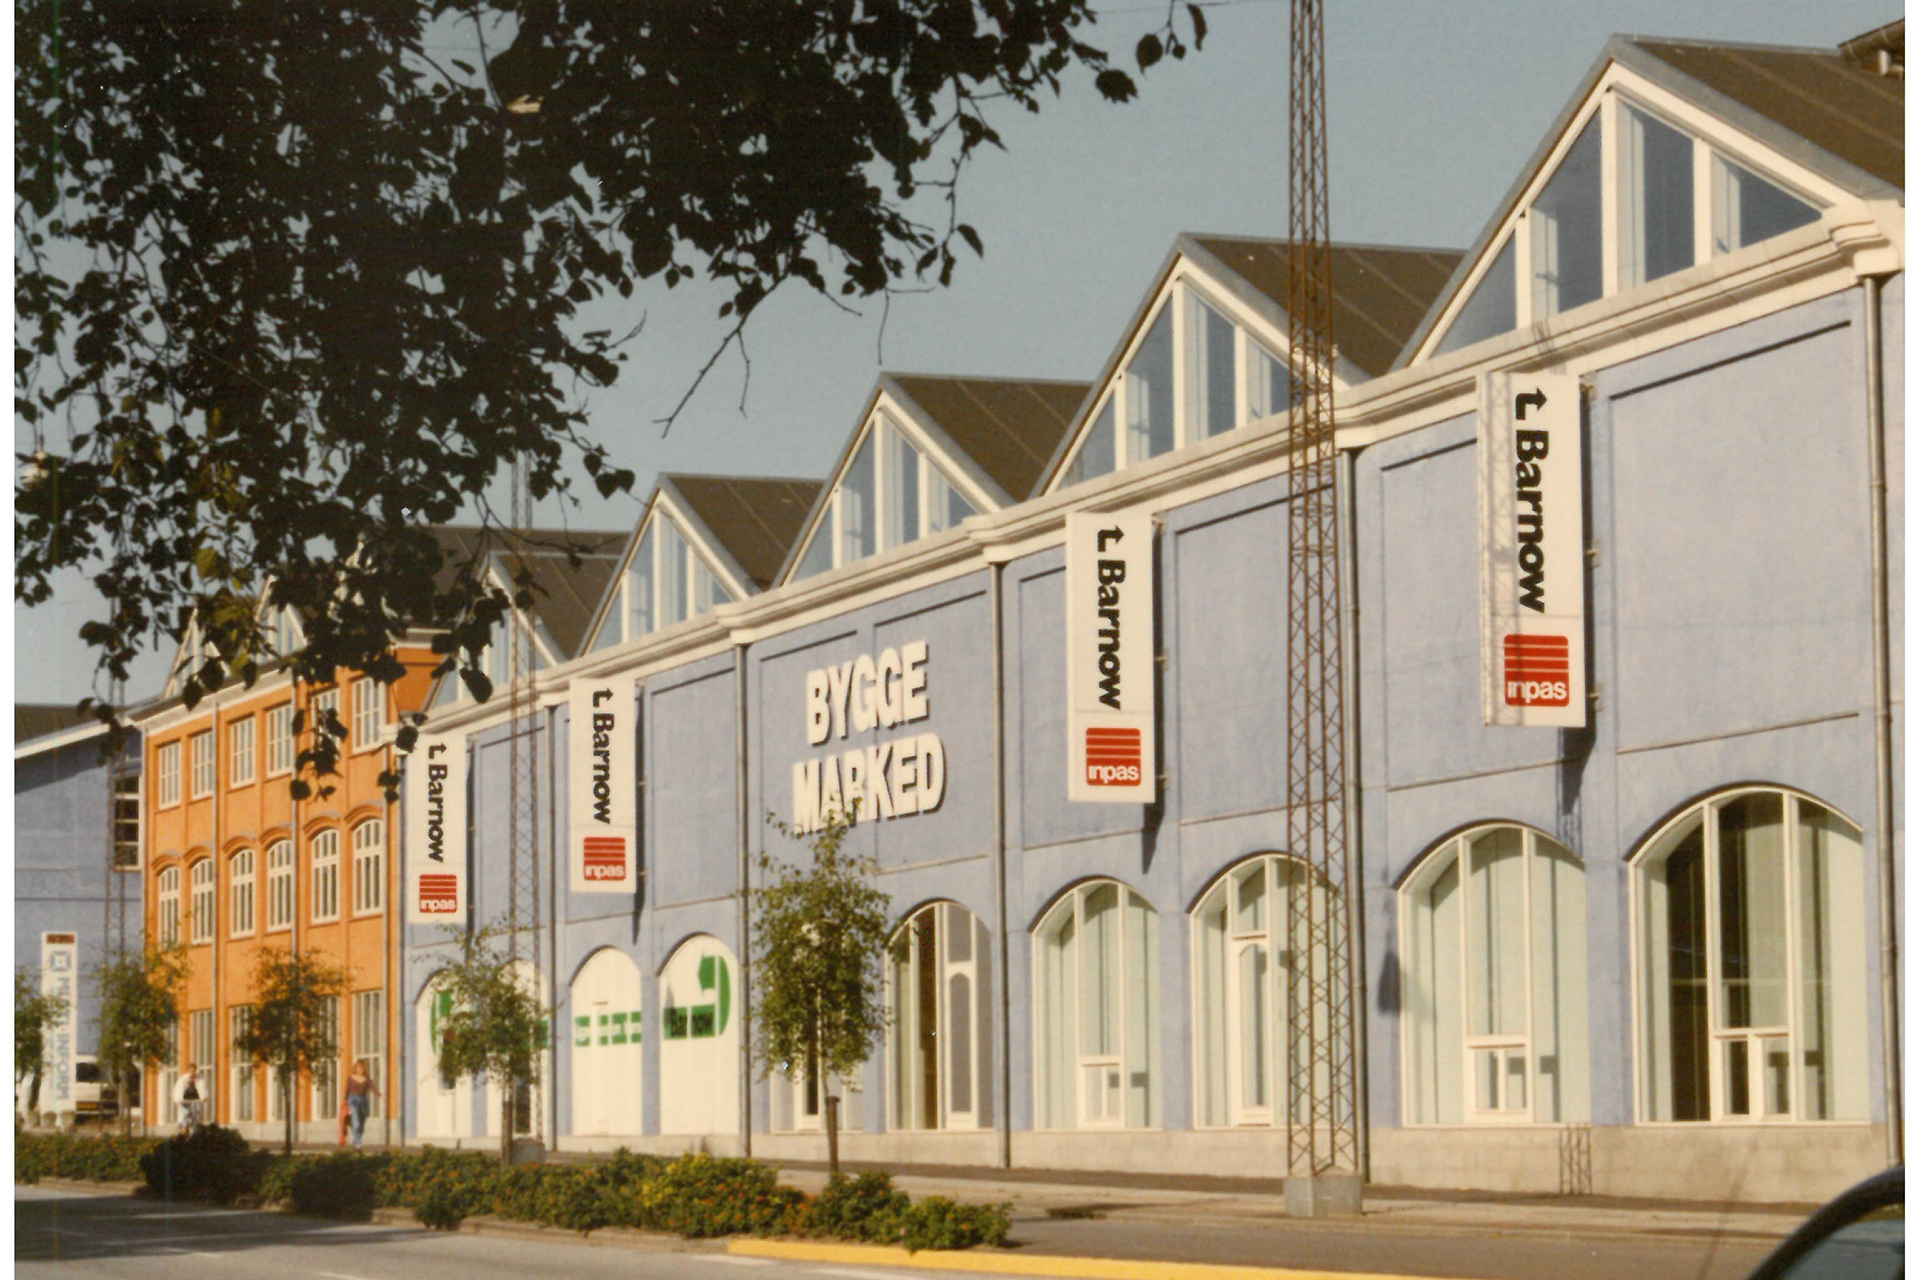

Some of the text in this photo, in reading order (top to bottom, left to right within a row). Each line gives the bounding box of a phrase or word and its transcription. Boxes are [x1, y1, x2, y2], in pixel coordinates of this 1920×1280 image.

[1515, 429, 1549, 614] Barnow
[1097, 559, 1126, 710] Barnow
[806, 639, 929, 746] BYGGE
[1507, 680, 1567, 705] inpas
[428, 764, 448, 863] Barnow
[592, 713, 615, 825] Barnow
[792, 732, 947, 838] MARKED
[1088, 764, 1139, 784] inpas
[585, 864, 625, 880] inpas
